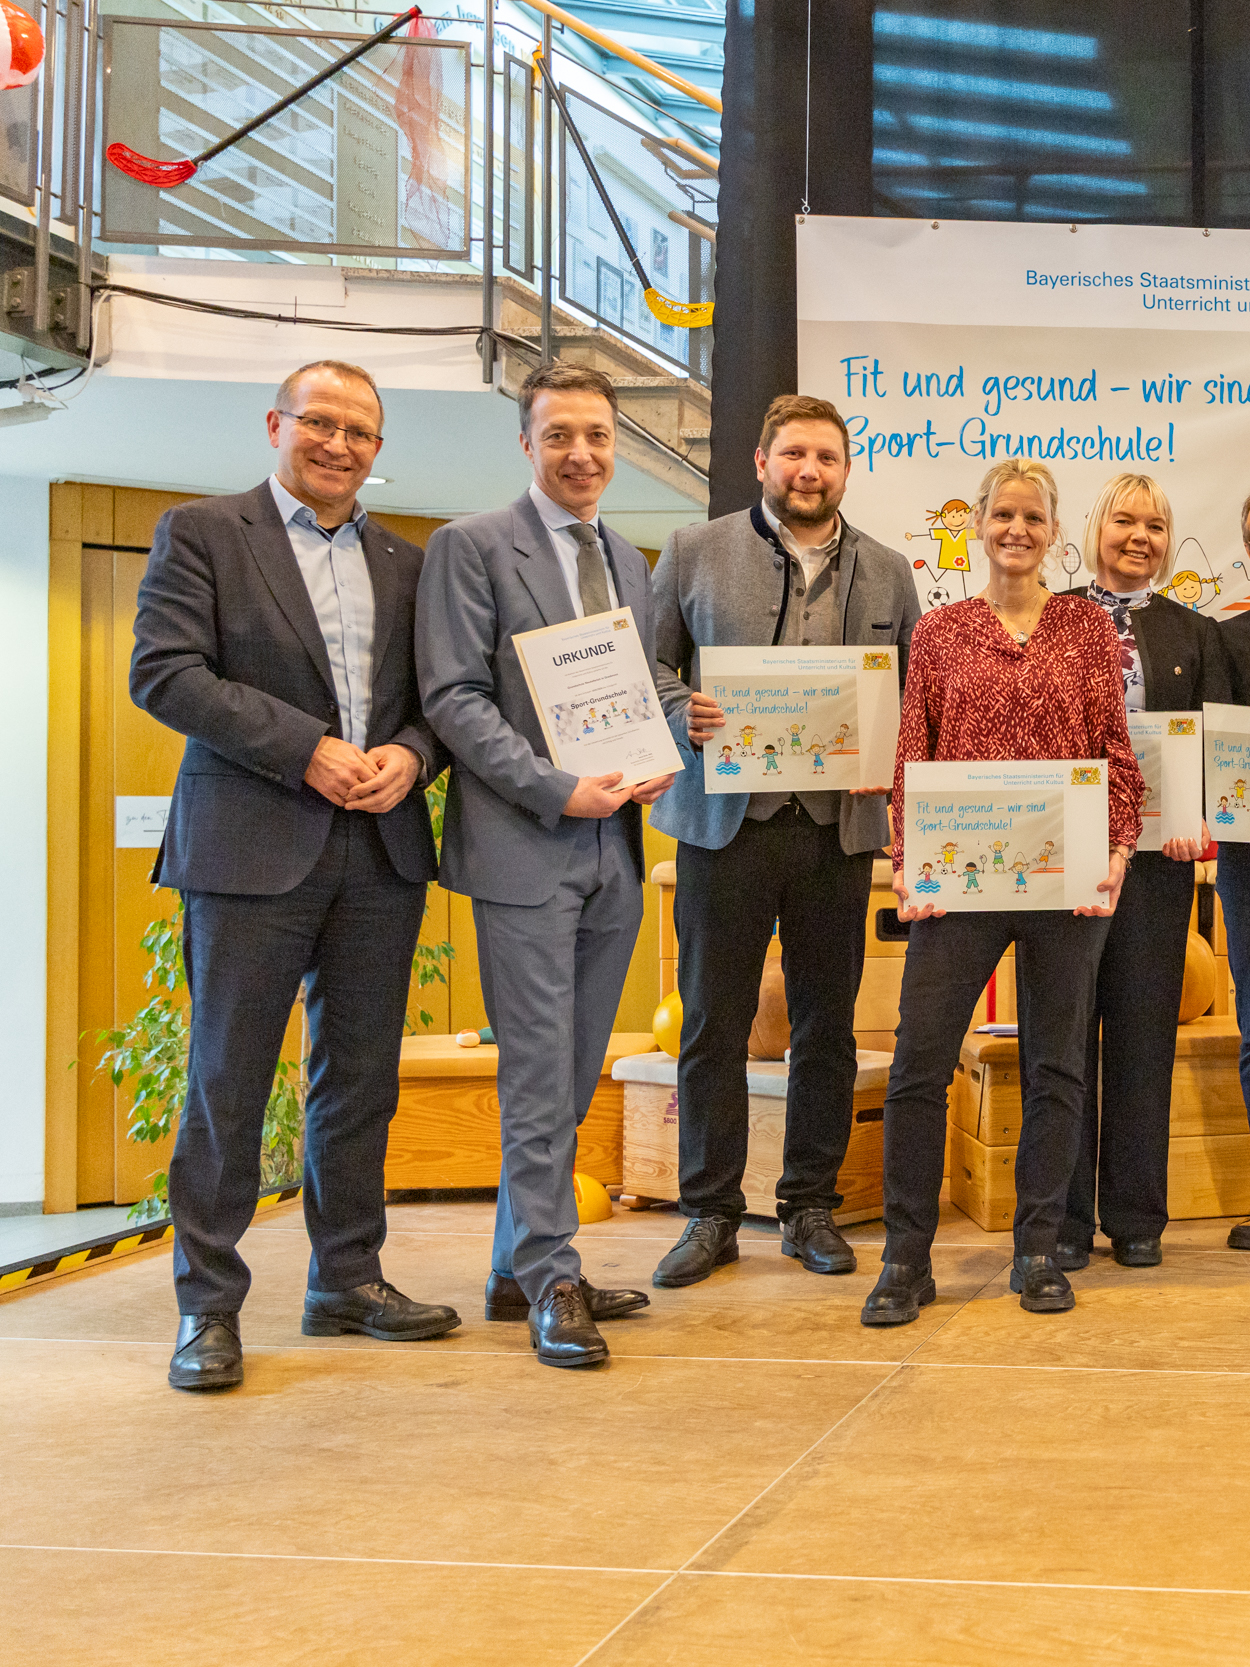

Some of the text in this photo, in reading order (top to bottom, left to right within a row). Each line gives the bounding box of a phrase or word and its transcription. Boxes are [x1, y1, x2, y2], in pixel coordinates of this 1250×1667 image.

[1026, 270, 1133, 289] Bayerisches
[1143, 294, 1232, 313] Unterricht
[840, 356, 886, 398] Fit
[903, 365, 964, 401] und
[982, 368, 1097, 416] gesund
[1142, 374, 1191, 404] wir
[844, 415, 1176, 472] Sport-Grundschule!
[552, 641, 616, 667] URKUNDE
[570, 689, 628, 709] Sport-Grundschule
[713, 685, 727, 698] Fit
[732, 687, 750, 697] und
[755, 687, 789, 702] gesund
[803, 688, 818, 697] wir
[821, 686, 839, 696] sind
[1135, 750, 1145, 760] nd
[1214, 740, 1224, 751] Fit
[1228, 744, 1242, 753] und
[917, 801, 930, 814] Fit
[935, 803, 953, 813] und
[958, 803, 993, 818] gesund
[1008, 804, 1023, 812] wir
[1027, 802, 1045, 812] sind
[916, 818, 1012, 835] Sport-Grundschule!
